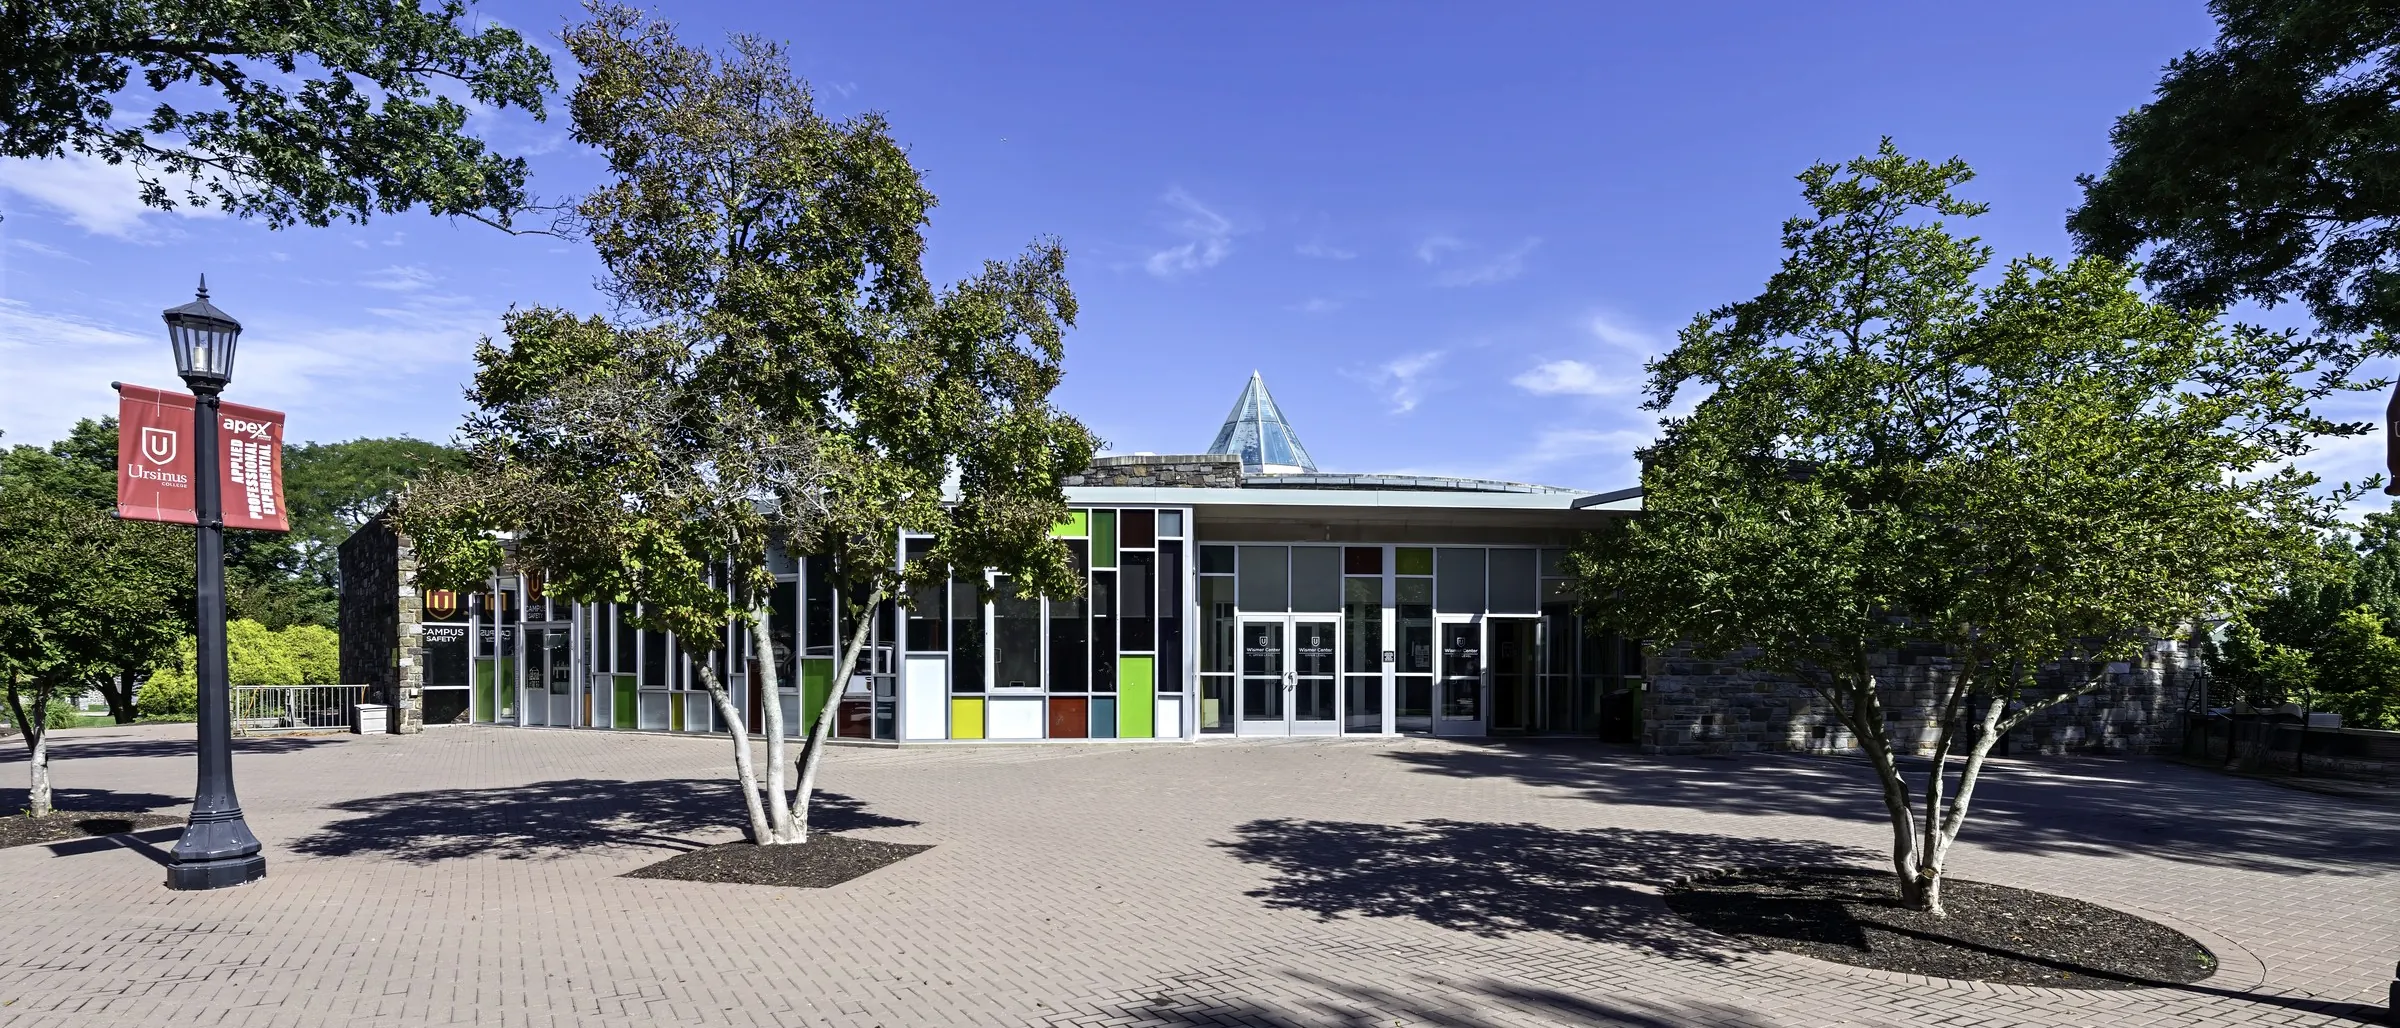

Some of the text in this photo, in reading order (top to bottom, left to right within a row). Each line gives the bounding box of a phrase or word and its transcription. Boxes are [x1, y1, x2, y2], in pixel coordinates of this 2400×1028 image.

[223, 418, 272, 439] apex
[152, 436, 167, 456] U
[230, 439, 245, 484] APPLIED
[128, 463, 187, 484] Ursinus
[244, 442, 263, 520] PROFESSIONAL
[259, 443, 276, 516] EXPERIENTIAL
[434, 595, 448, 611] U
